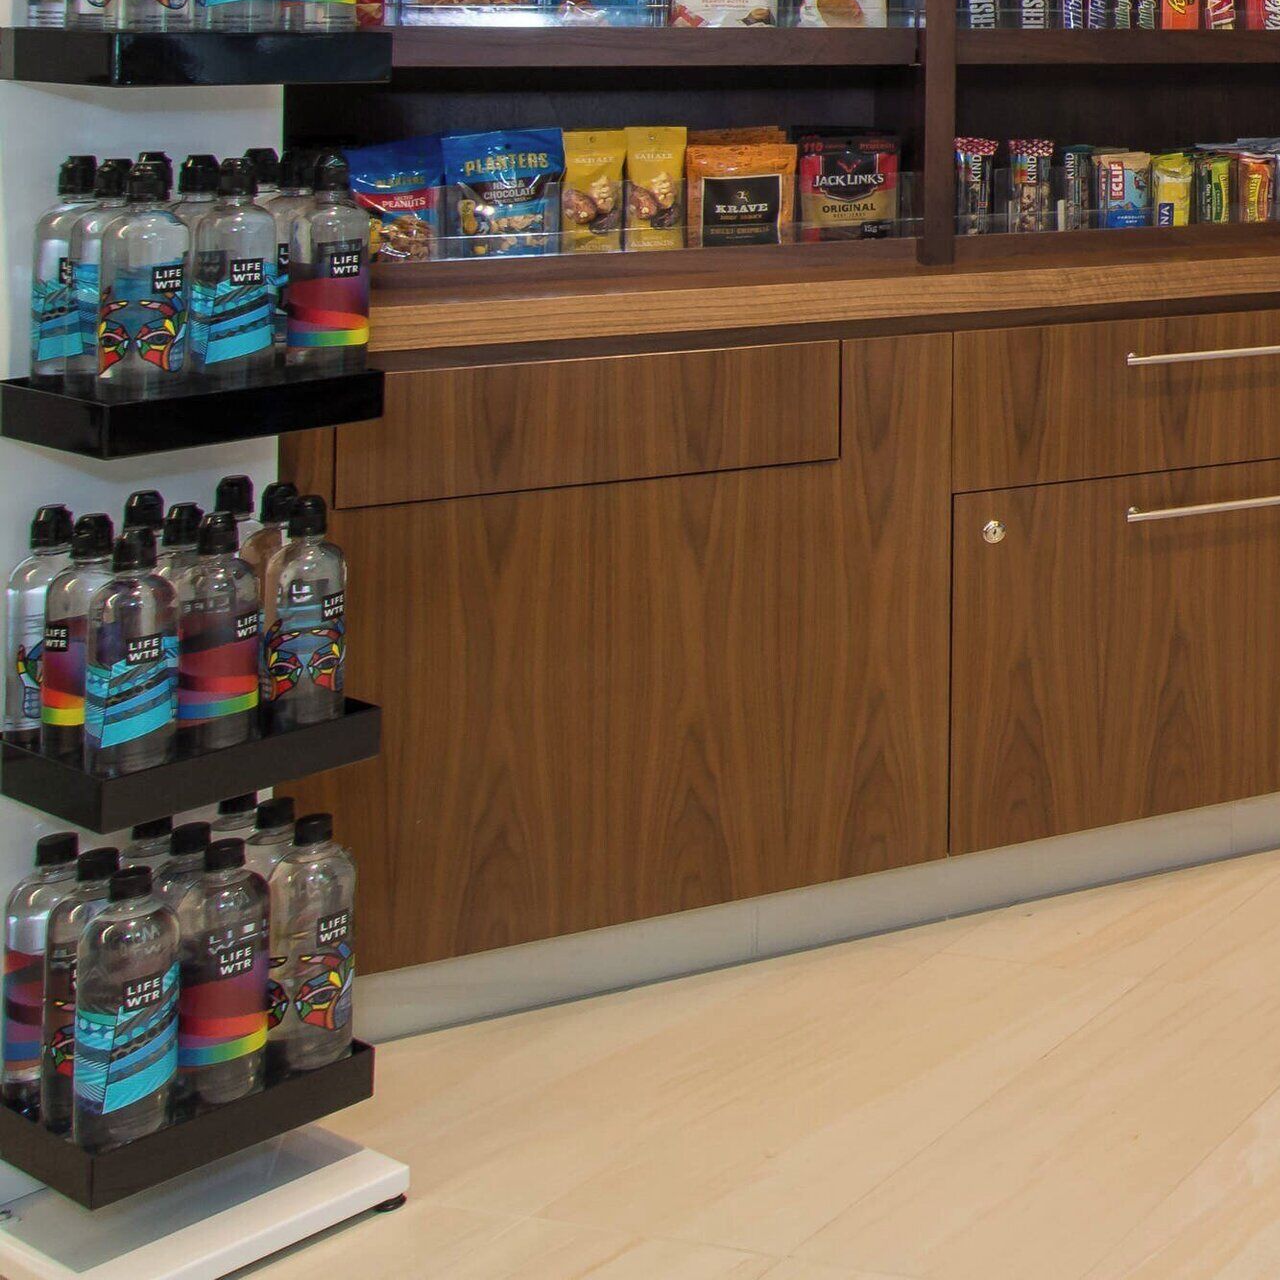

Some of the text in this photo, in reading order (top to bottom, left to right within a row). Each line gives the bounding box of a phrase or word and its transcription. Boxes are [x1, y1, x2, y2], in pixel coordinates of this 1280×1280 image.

[465, 153, 549, 176] PLANTERS
[971, 155, 982, 182] KIND
[1027, 155, 1037, 183] KIND
[1066, 153, 1075, 179] KIND
[814, 173, 884, 187] JACK LINK'S
[484, 187, 535, 200] CHOCOLATE
[382, 198, 426, 209] PEANUTS
[716, 204, 768, 214] KRAVE
[822, 203, 876, 213] ORIGINAL
[233, 261, 261, 272] LIFE
[333, 254, 359, 265] LIFE
[156, 268, 182, 280] LIFE
[332, 264, 359, 275] WTR
[155, 278, 182, 290] WTR
[232, 271, 262, 283] WTR
[45, 627, 67, 639] LIFE
[44, 638, 67, 649] WTR
[129, 638, 160, 653] LIFE
[129, 648, 160, 663] WTR
[320, 914, 348, 932] LIFE
[319, 925, 348, 943] WTR
[220, 946, 252, 964] LIFE
[219, 958, 252, 976] WTR
[127, 978, 161, 996] LIFE
[126, 990, 161, 1008] WTR
